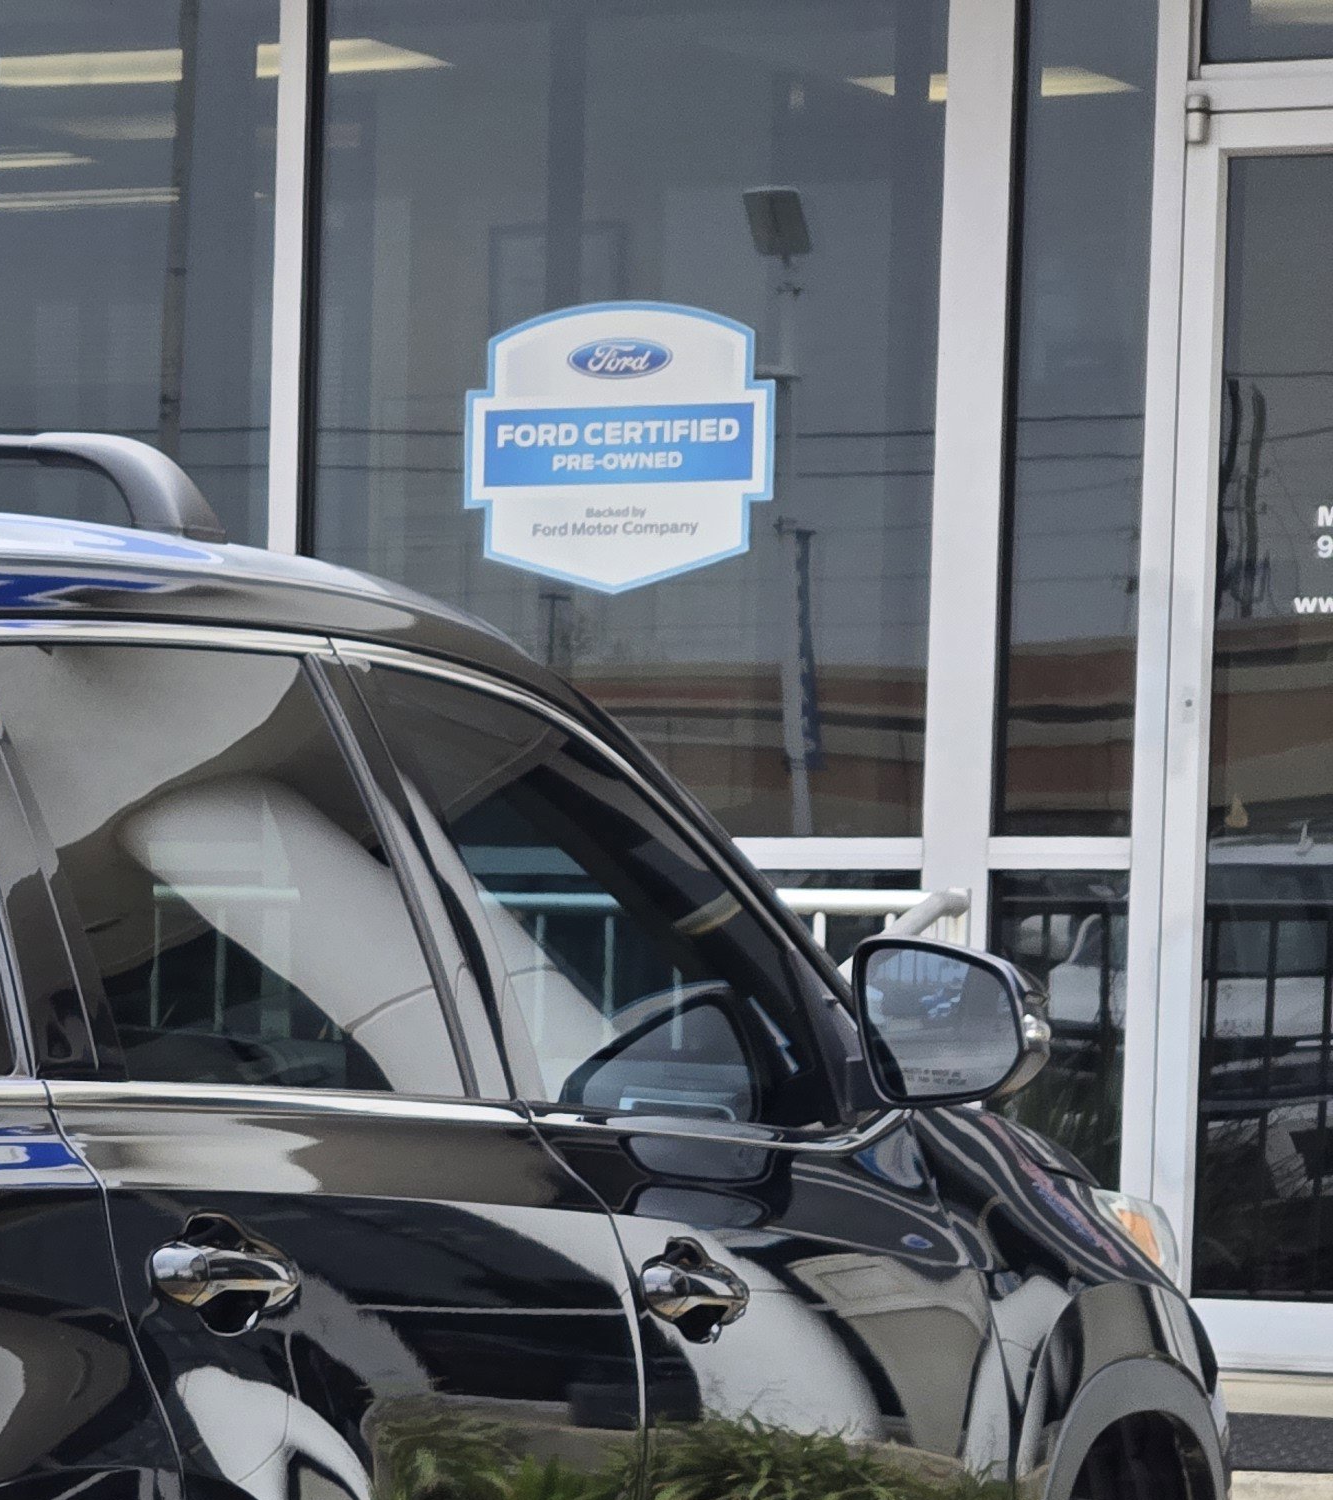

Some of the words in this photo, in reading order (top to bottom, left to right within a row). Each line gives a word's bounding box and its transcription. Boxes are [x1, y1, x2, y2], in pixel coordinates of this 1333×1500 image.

[588, 345, 650, 372] Ford
[497, 424, 578, 447] FORD
[584, 418, 740, 445] CERTIFIED
[552, 452, 683, 470] PRE-OWNED
[585, 506, 630, 518] Backed
[632, 506, 647, 519] by
[532, 522, 568, 537] Ford
[571, 522, 618, 536] Motor
[622, 520, 700, 536] Company
